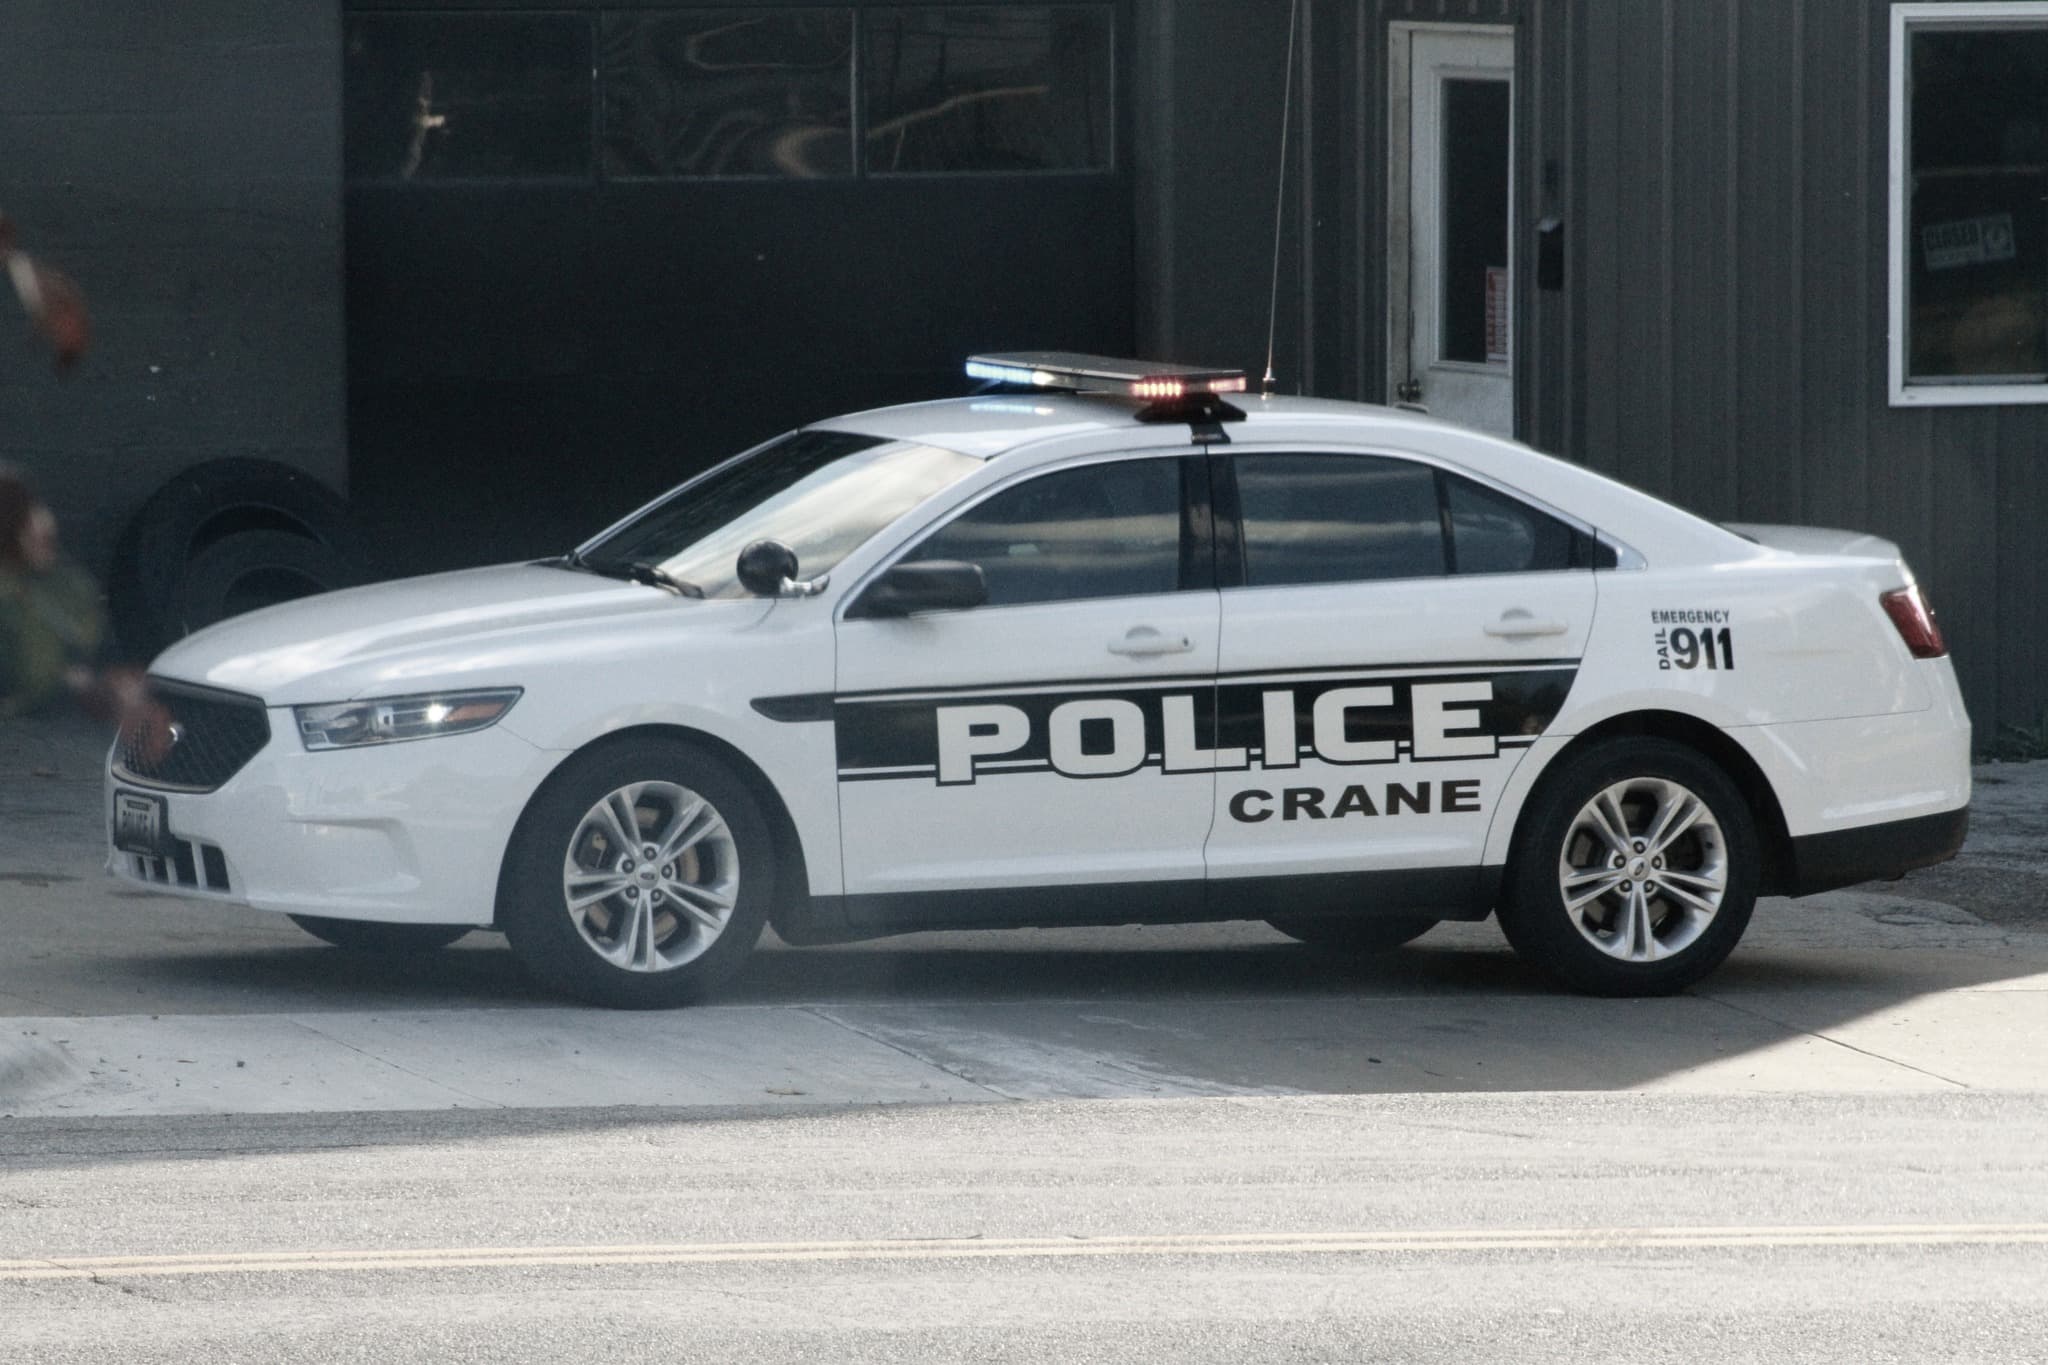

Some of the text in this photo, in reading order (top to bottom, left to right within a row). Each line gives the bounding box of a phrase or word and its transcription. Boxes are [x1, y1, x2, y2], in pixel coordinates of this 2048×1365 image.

[1651, 610, 1730, 624] EMERGENCY
[1669, 627, 1735, 670] 911
[936, 681, 1498, 785] POLICE
[1229, 779, 1481, 823] CRANE
